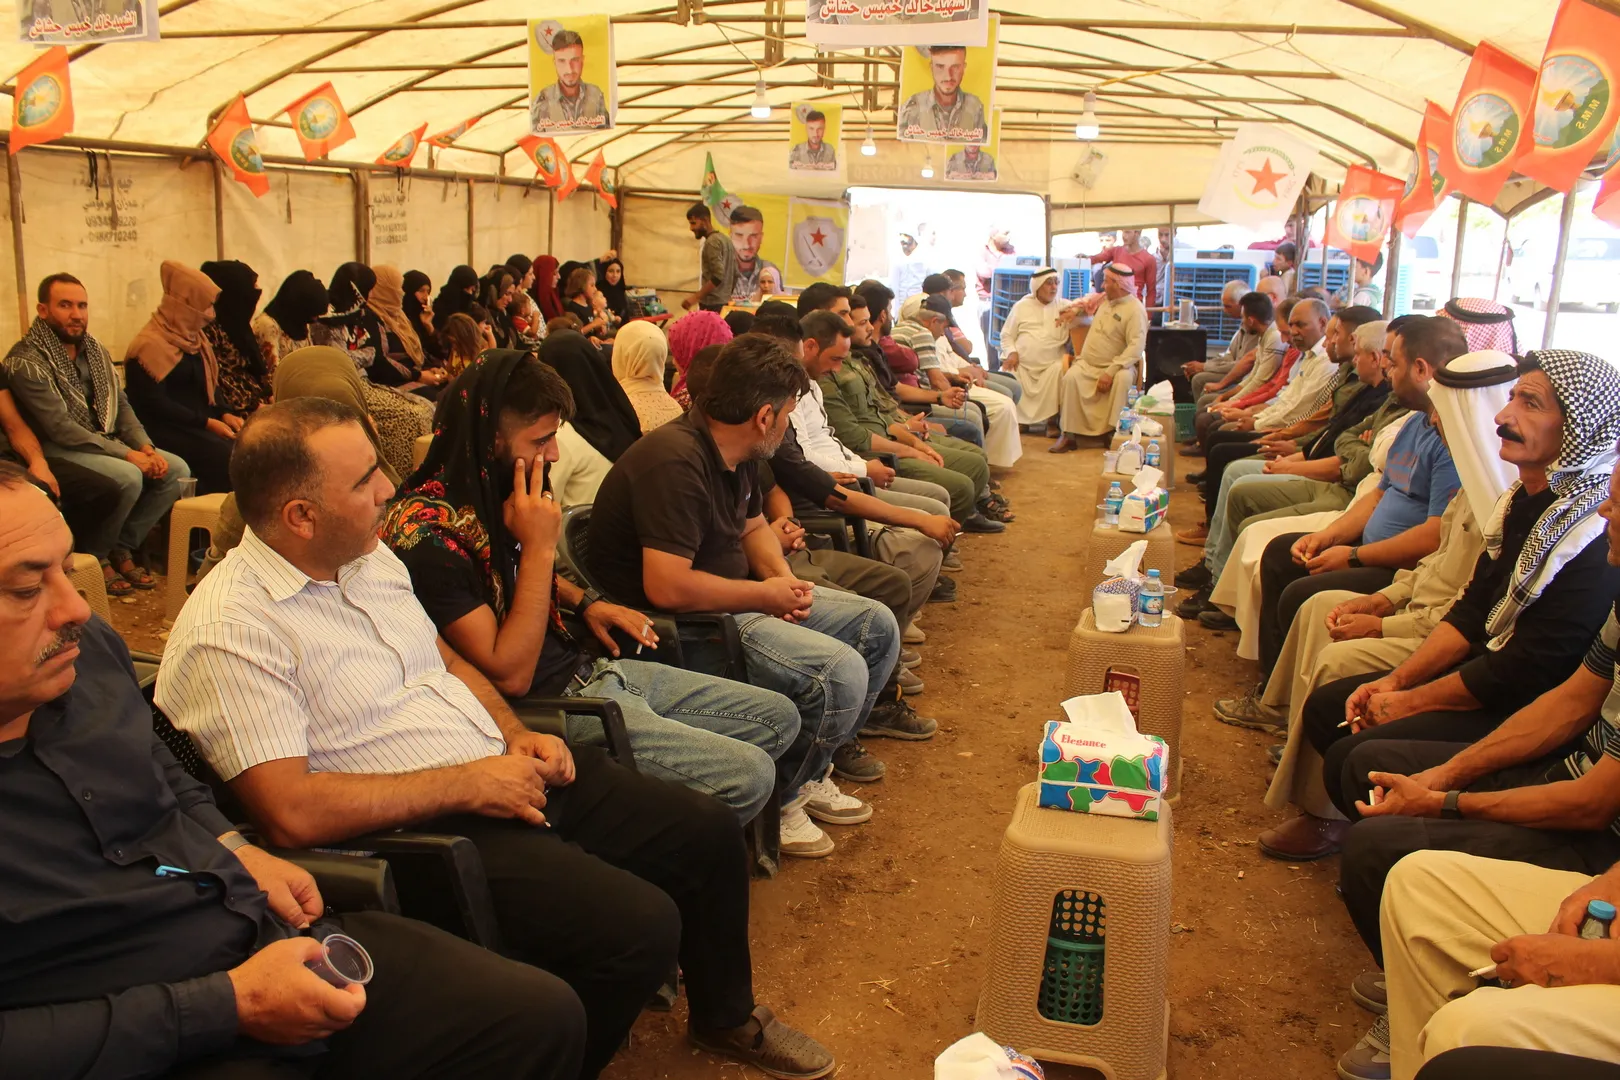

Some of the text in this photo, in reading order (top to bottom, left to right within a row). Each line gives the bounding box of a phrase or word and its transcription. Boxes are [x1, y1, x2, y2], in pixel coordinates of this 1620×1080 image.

[820, 0, 860, 18] حشاش
[862, 0, 903, 19] خميس
[29, 17, 62, 38] حشاش
[63, 16, 92, 36] خميس
[904, 125, 926, 137] حشاش
[1061, 734, 1107, 748] Elegance
